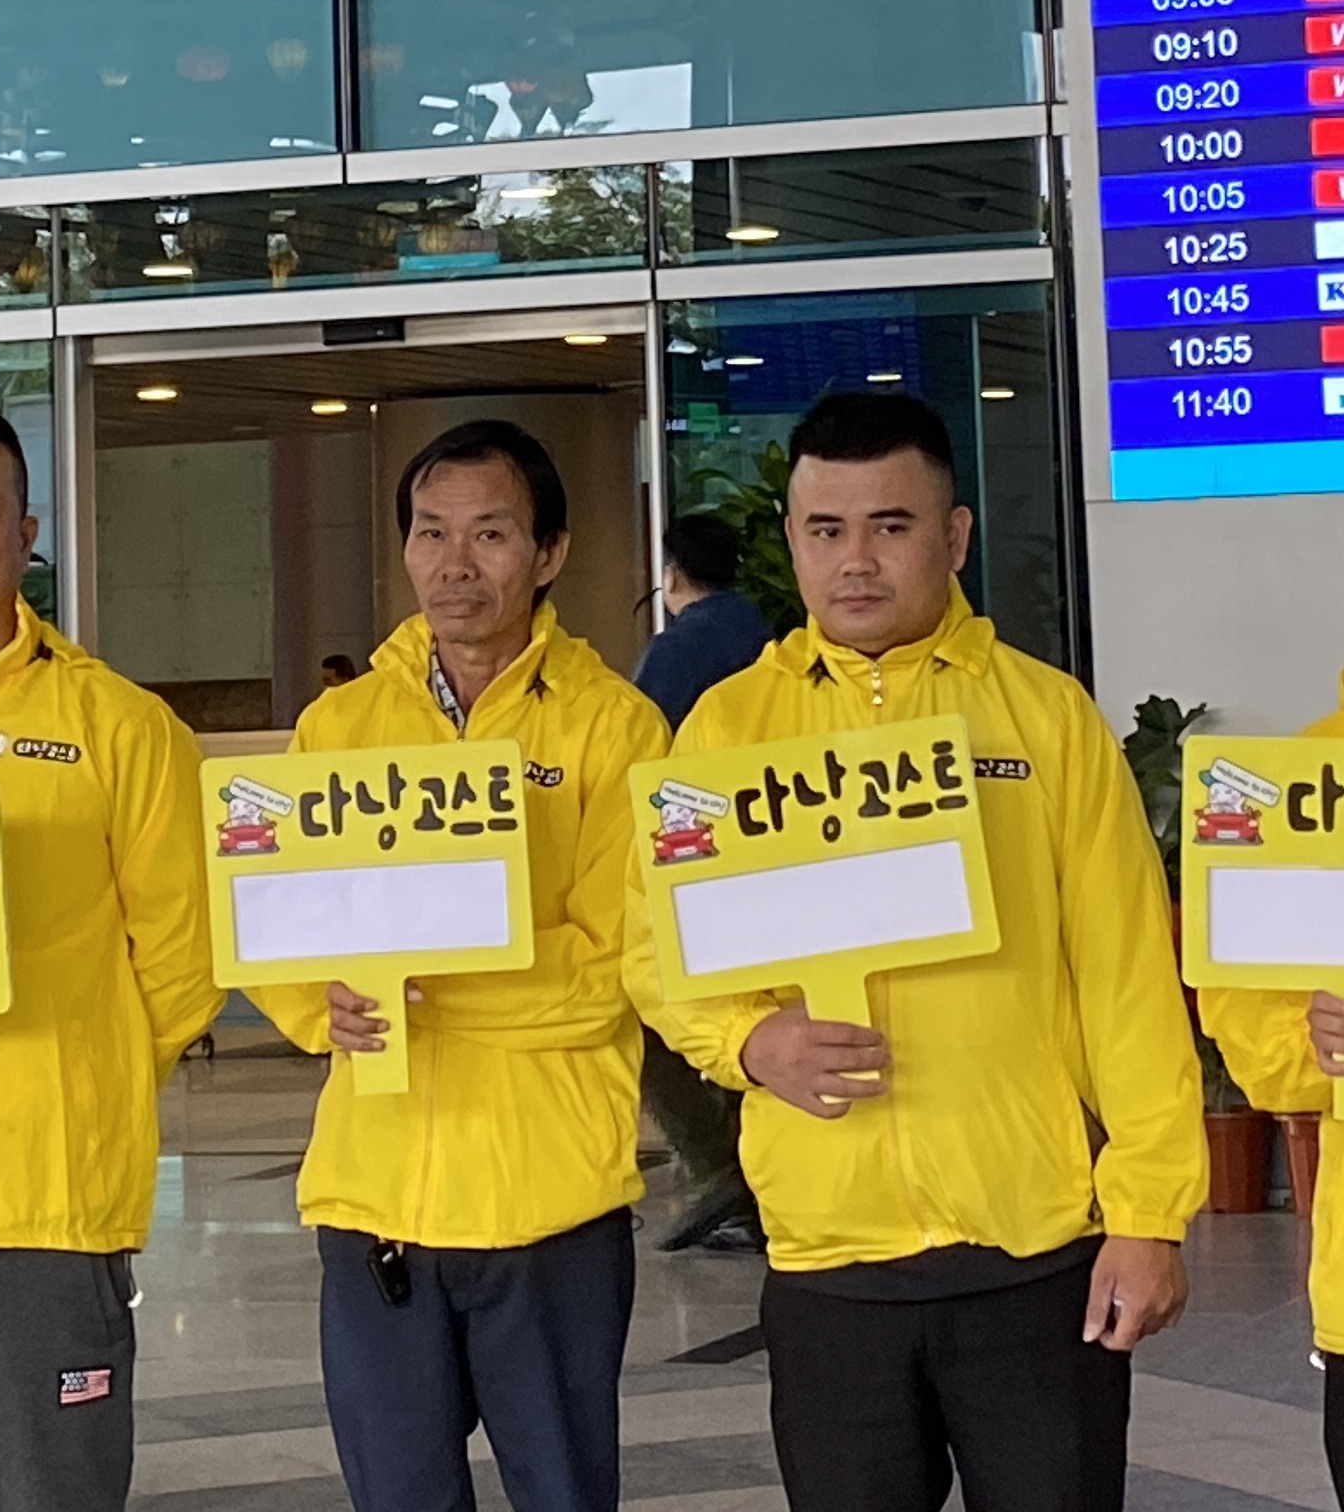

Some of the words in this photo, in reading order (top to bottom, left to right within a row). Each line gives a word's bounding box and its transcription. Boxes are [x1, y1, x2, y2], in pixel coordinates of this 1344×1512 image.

[1153, 28, 1238, 62] 09:10
[1156, 79, 1240, 112] 09:20
[1160, 129, 1243, 163] 10:00
[1162, 180, 1246, 213] 10:05
[1164, 231, 1248, 265] 10:25
[1167, 283, 1250, 316] 10:45
[1168, 334, 1253, 367] 10:55
[1172, 387, 1252, 418] 11:40
